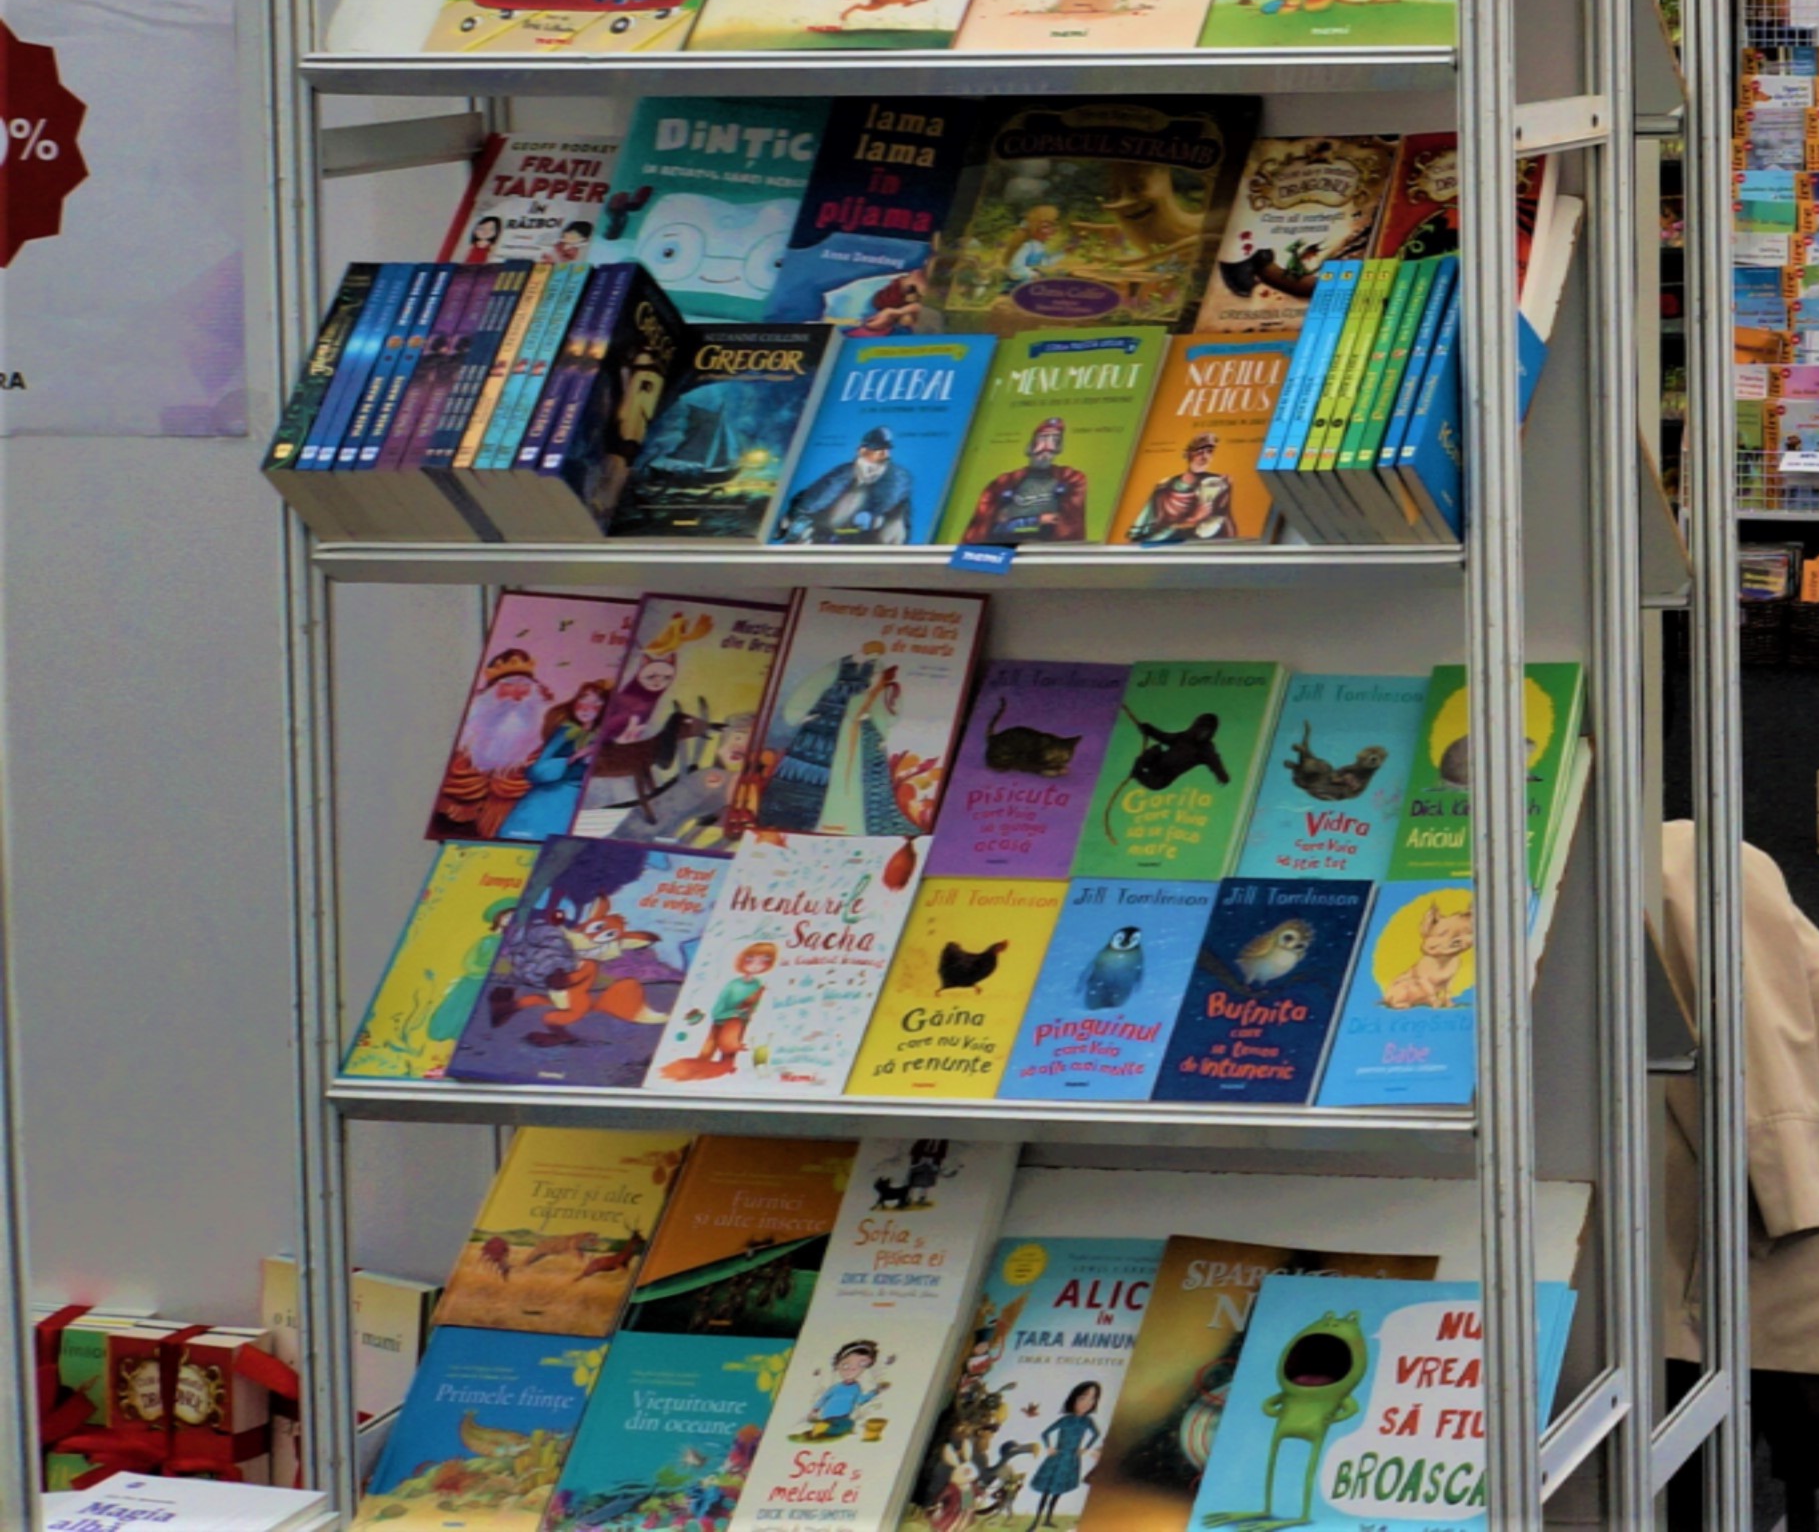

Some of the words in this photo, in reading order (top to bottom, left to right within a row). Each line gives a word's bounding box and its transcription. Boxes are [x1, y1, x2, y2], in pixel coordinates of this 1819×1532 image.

[864, 103, 945, 137] lama
[511, 141, 556, 153] GEOFF
[560, 142, 619, 155] RODKEY
[854, 133, 937, 168] lama
[1002, 132, 1114, 156] COPACUL
[518, 154, 603, 180] FRAȚII
[493, 175, 611, 204] TAPPER
[528, 200, 547, 215] ÎN
[815, 196, 934, 233] pijama
[694, 344, 806, 375] GREGOR
[840, 368, 957, 403] DECEBAL
[989, 670, 1019, 688] Jill
[1033, 670, 1122, 688] Tomlinson
[1137, 669, 1169, 688] Jill
[1179, 670, 1267, 687] Tomlinson
[1292, 683, 1325, 704] Jill
[1335, 684, 1425, 704] Tomlinson
[1122, 786, 1213, 814] Gorila
[1410, 798, 1445, 816] Dick
[1304, 810, 1371, 837] Vidra
[1294, 839, 1326, 852] care
[1405, 826, 1466, 848] Ariciul
[1128, 841, 1180, 860] mare
[729, 873, 868, 925] Aventurile
[925, 888, 956, 907] Jill
[969, 889, 1059, 908] Tomlinson
[1073, 886, 1108, 906] Jill
[1117, 886, 1209, 908] Tomlinson
[1222, 886, 1258, 906] Jill
[1267, 886, 1361, 907] Tomlinson
[785, 918, 876, 953] Sacha
[902, 1005, 986, 1034] Găina
[1207, 991, 1310, 1025] Bufnița
[1034, 1013, 1164, 1046] Pinguinul
[897, 1035, 933, 1052] care
[937, 1035, 959, 1047] nu
[1382, 1042, 1431, 1064] Babe
[872, 1060, 895, 1077] să
[902, 1052, 993, 1077] renunțe
[531, 1179, 578, 1204] Tigri
[603, 1184, 645, 1205] alte
[853, 1217, 913, 1246] Sofia
[873, 1248, 923, 1270] pisica
[927, 1248, 947, 1267] ei
[1053, 1278, 1150, 1312] ALIC
[1097, 1309, 1114, 1326] ÎN
[1014, 1329, 1065, 1351] ȚARA
[1070, 1330, 1137, 1349] MINUN
[1396, 1355, 1483, 1389] VREA
[434, 1382, 516, 1406] Primele
[516, 1388, 576, 1414] ființe
[631, 1389, 748, 1416] Viețuitoare
[625, 1410, 660, 1433] din
[663, 1416, 738, 1435] oceane
[1378, 1403, 1424, 1437] SĂ
[789, 1449, 848, 1480] Sofia
[767, 1480, 838, 1504] melcul
[841, 1485, 862, 1504] ei
[78, 1500, 177, 1523] Magia
